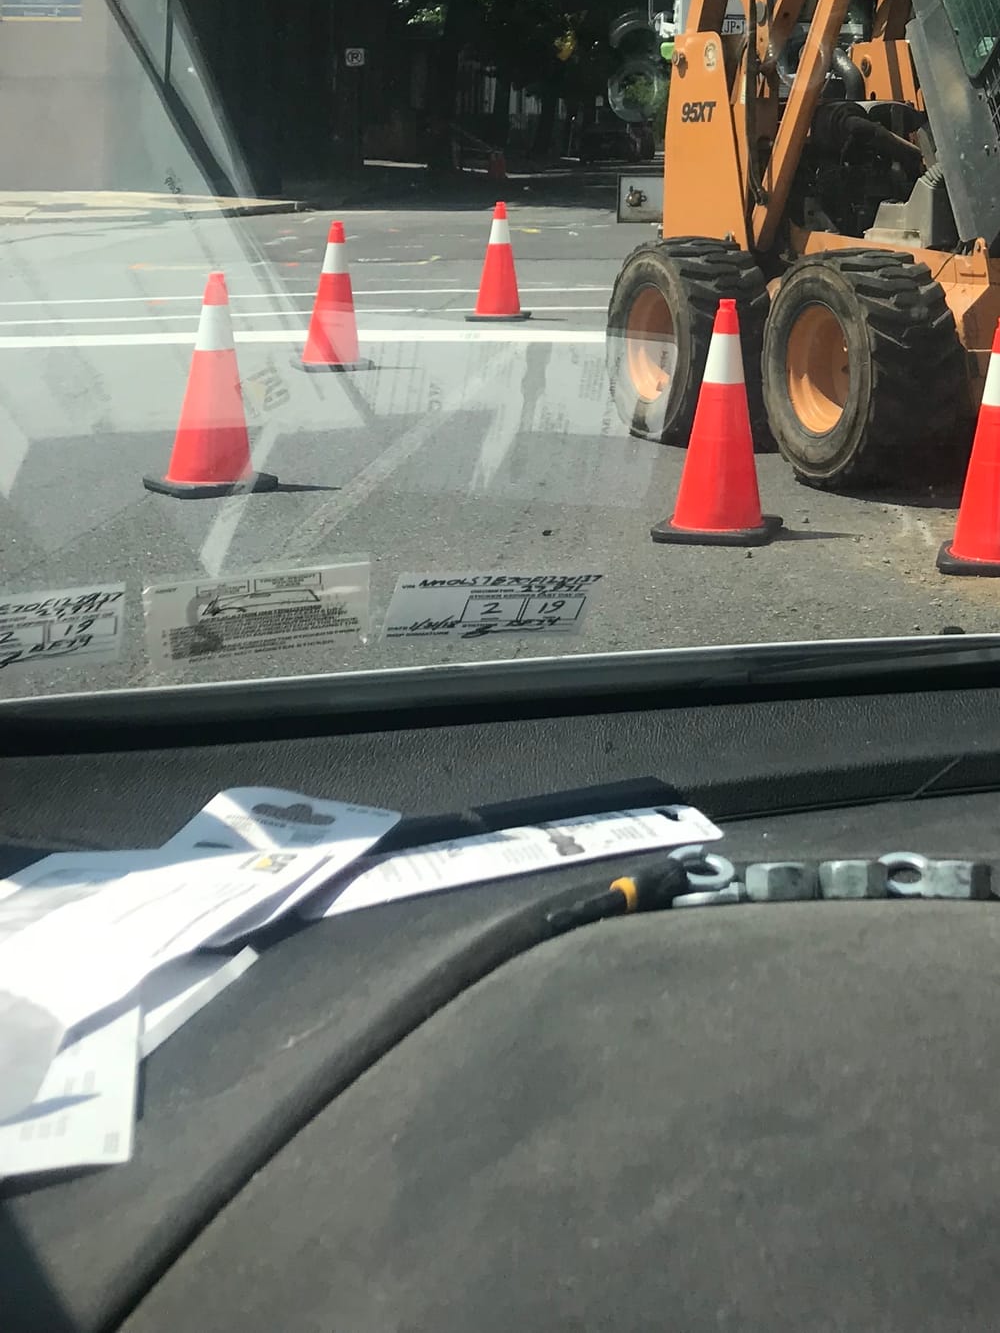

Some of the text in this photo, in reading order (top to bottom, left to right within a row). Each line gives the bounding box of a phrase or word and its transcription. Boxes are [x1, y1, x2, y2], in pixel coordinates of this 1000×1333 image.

[682, 101, 717, 123] 95XT
[481, 602, 503, 615] 2
[538, 600, 566, 614] 19
